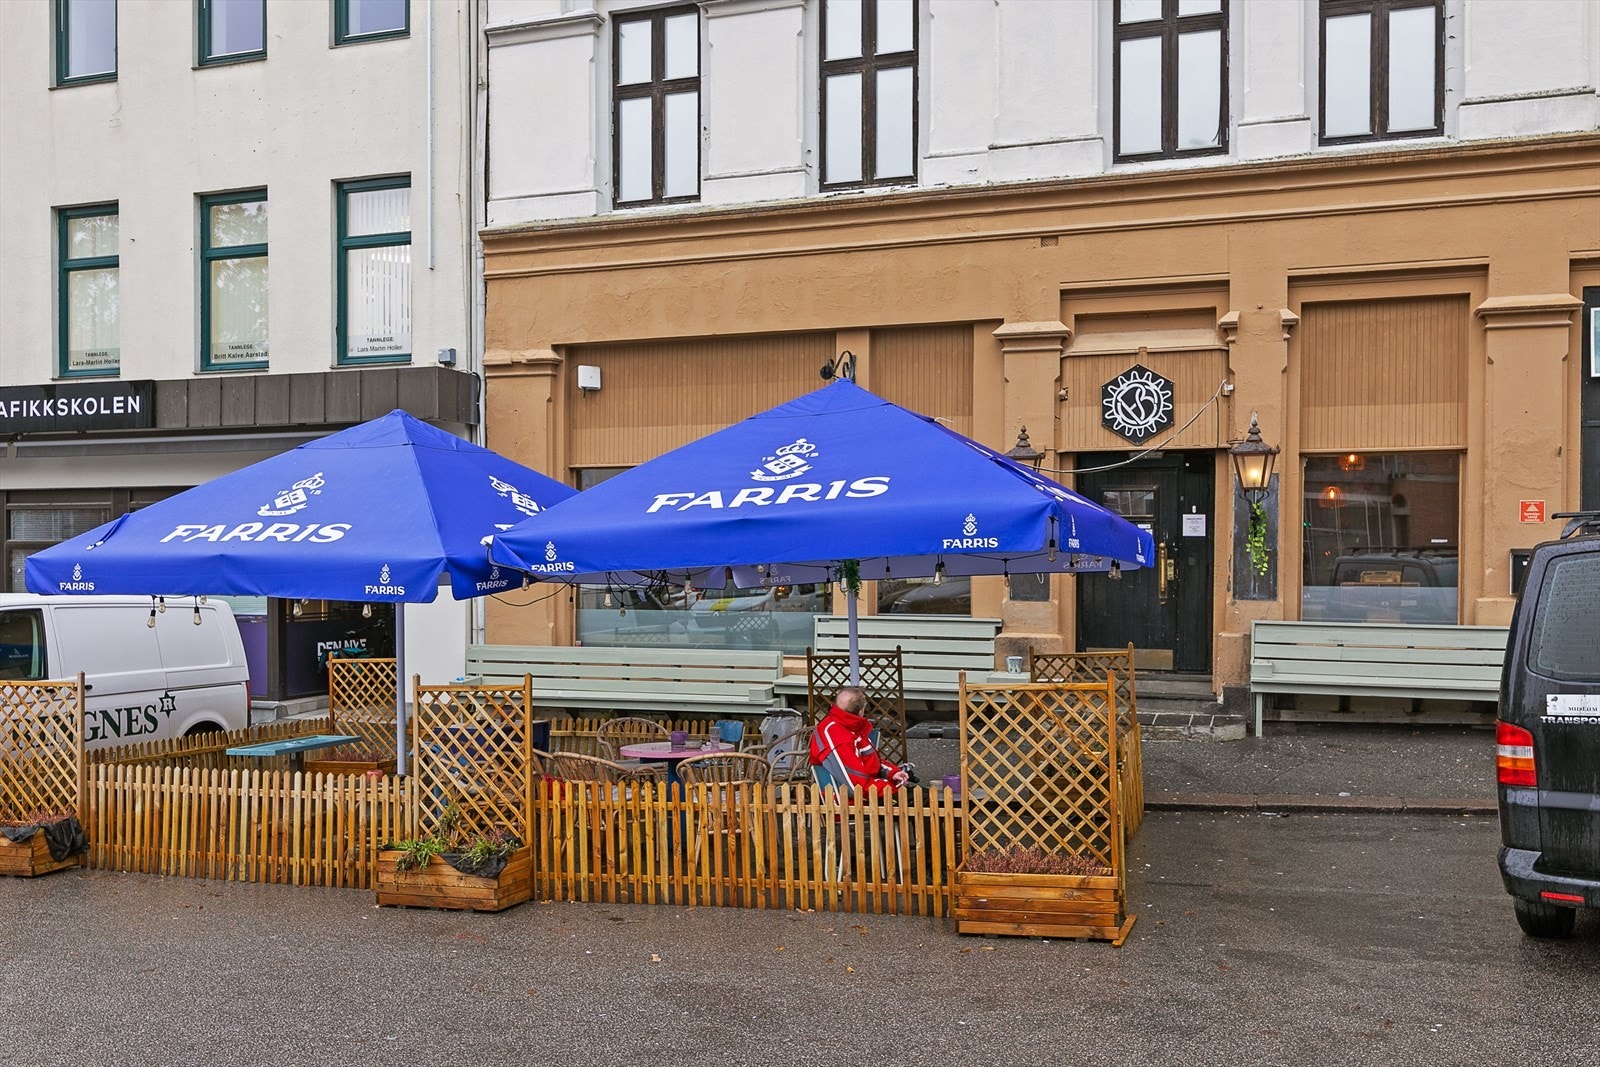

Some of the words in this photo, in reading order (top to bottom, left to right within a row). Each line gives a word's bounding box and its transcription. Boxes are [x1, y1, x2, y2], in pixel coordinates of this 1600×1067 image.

[245, 350, 268, 358] Aarstad
[646, 476, 891, 513] FARRIS
[160, 522, 352, 543] FARRIS
[942, 537, 999, 549] FARRIS
[531, 561, 575, 572] FARRIS
[59, 582, 95, 591] FARRIS
[364, 585, 405, 596] FARRIS
[476, 580, 509, 591] FARRIS
[1540, 716, 1600, 725] TRANSPO
